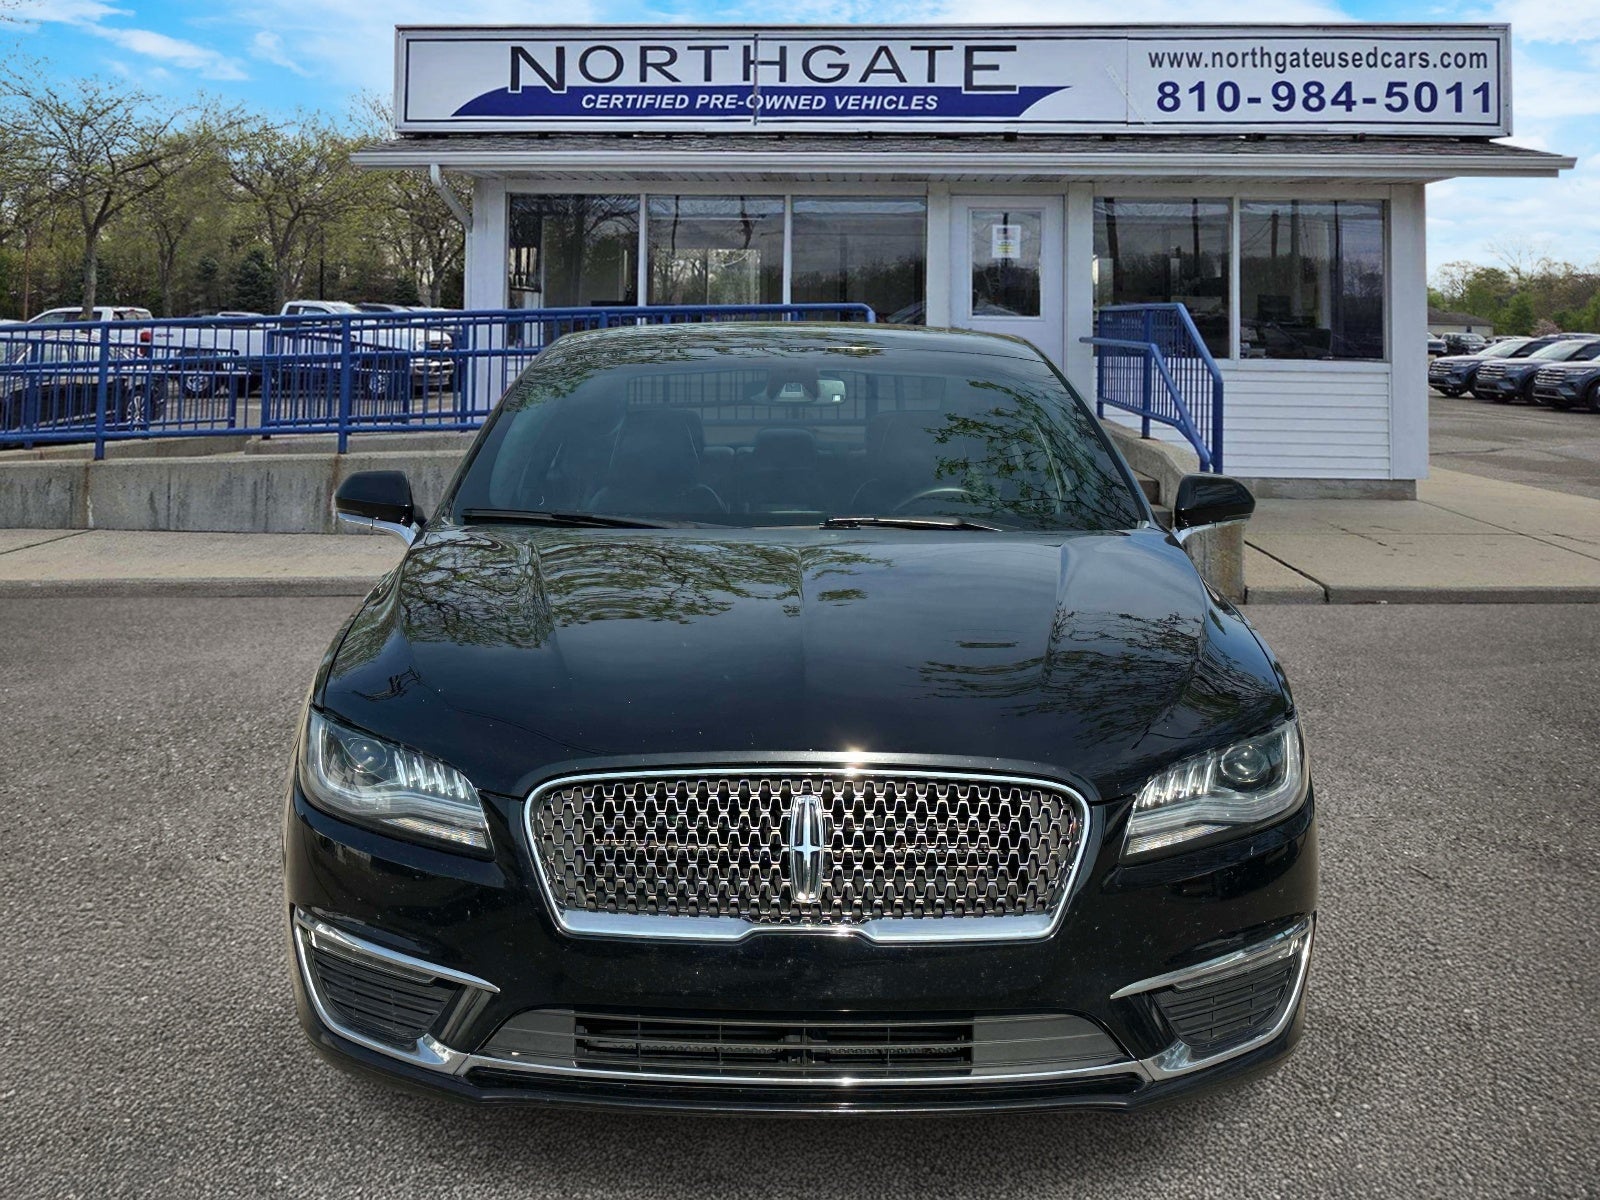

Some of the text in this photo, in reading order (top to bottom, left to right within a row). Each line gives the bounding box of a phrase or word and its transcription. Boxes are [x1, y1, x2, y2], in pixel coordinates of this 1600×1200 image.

[510, 45, 1017, 92] NORTHGATE
[1148, 46, 1488, 73] www.northgateusedcars.com
[581, 94, 938, 111] CERTIFIED PRE-OWNED VEHICLES
[1156, 81, 1491, 113] 810-984-5011
